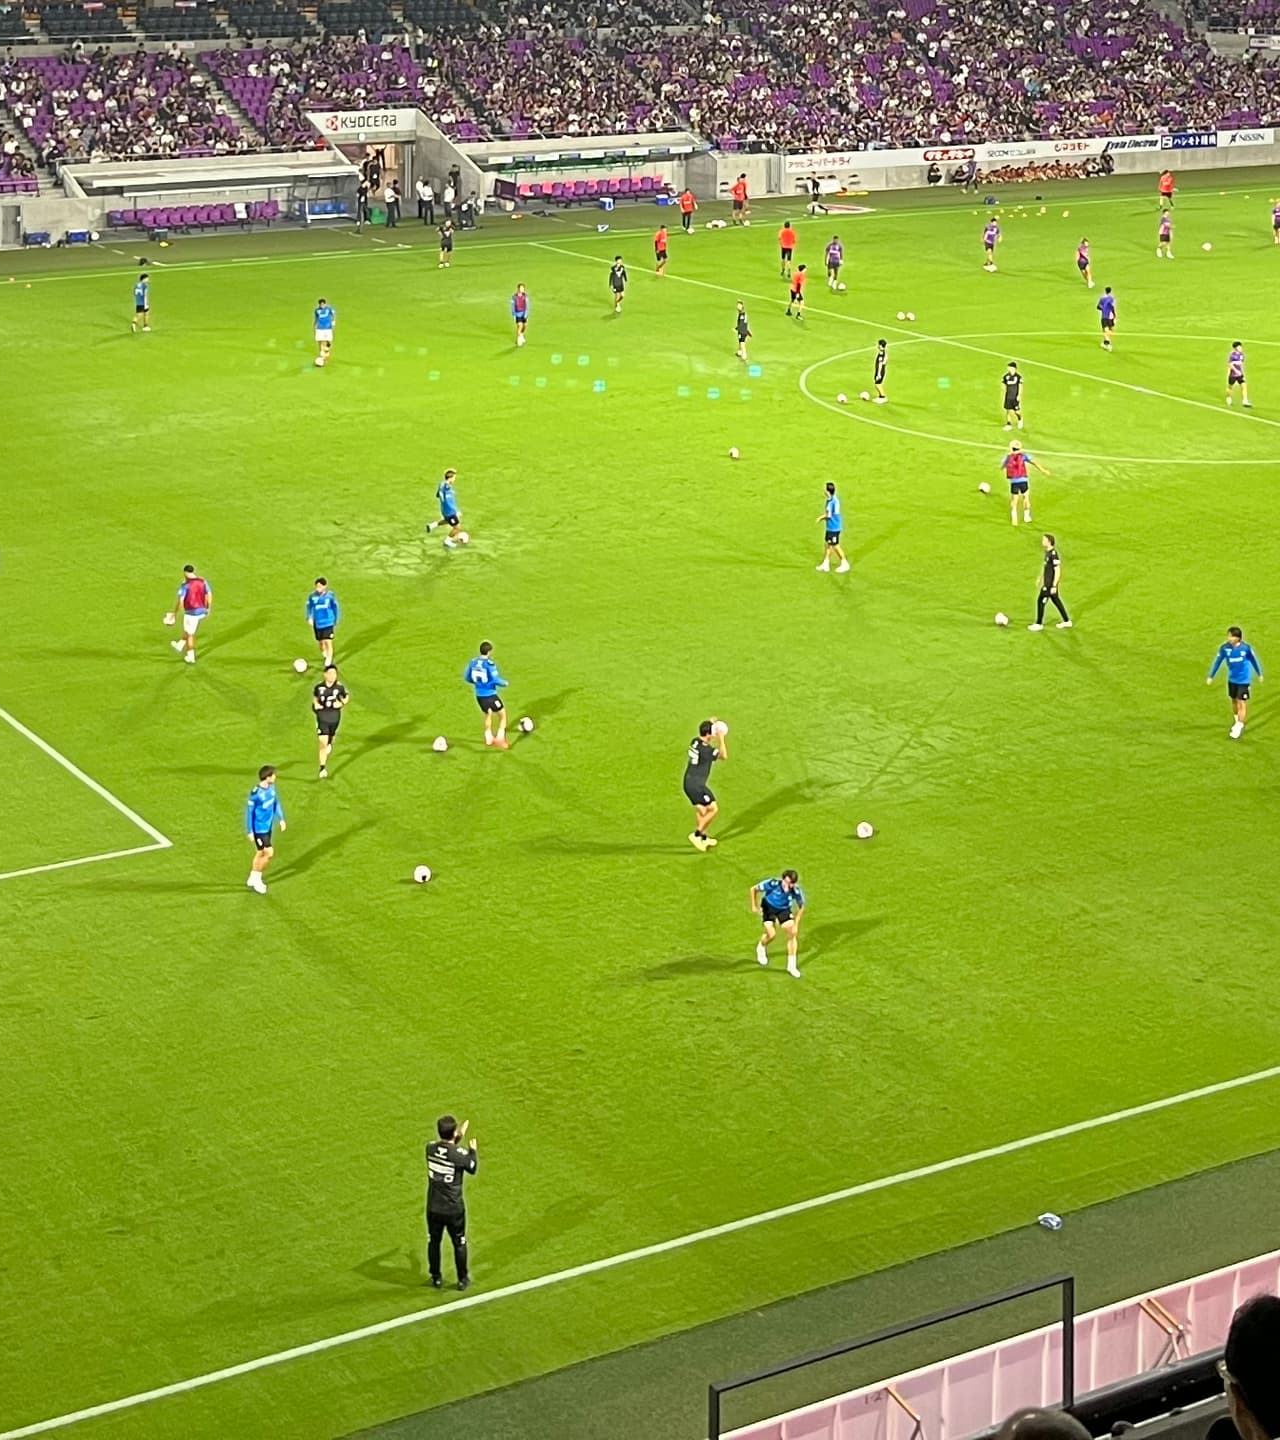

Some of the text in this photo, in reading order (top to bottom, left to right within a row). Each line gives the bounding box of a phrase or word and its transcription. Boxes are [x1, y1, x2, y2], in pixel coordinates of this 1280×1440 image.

[340, 114, 397, 128] KYOCERA
[1173, 133, 1217, 147] ハシモト精機
[1238, 133, 1266, 143] NISSIN
[787, 157, 851, 169] アサヒスーパードライ
